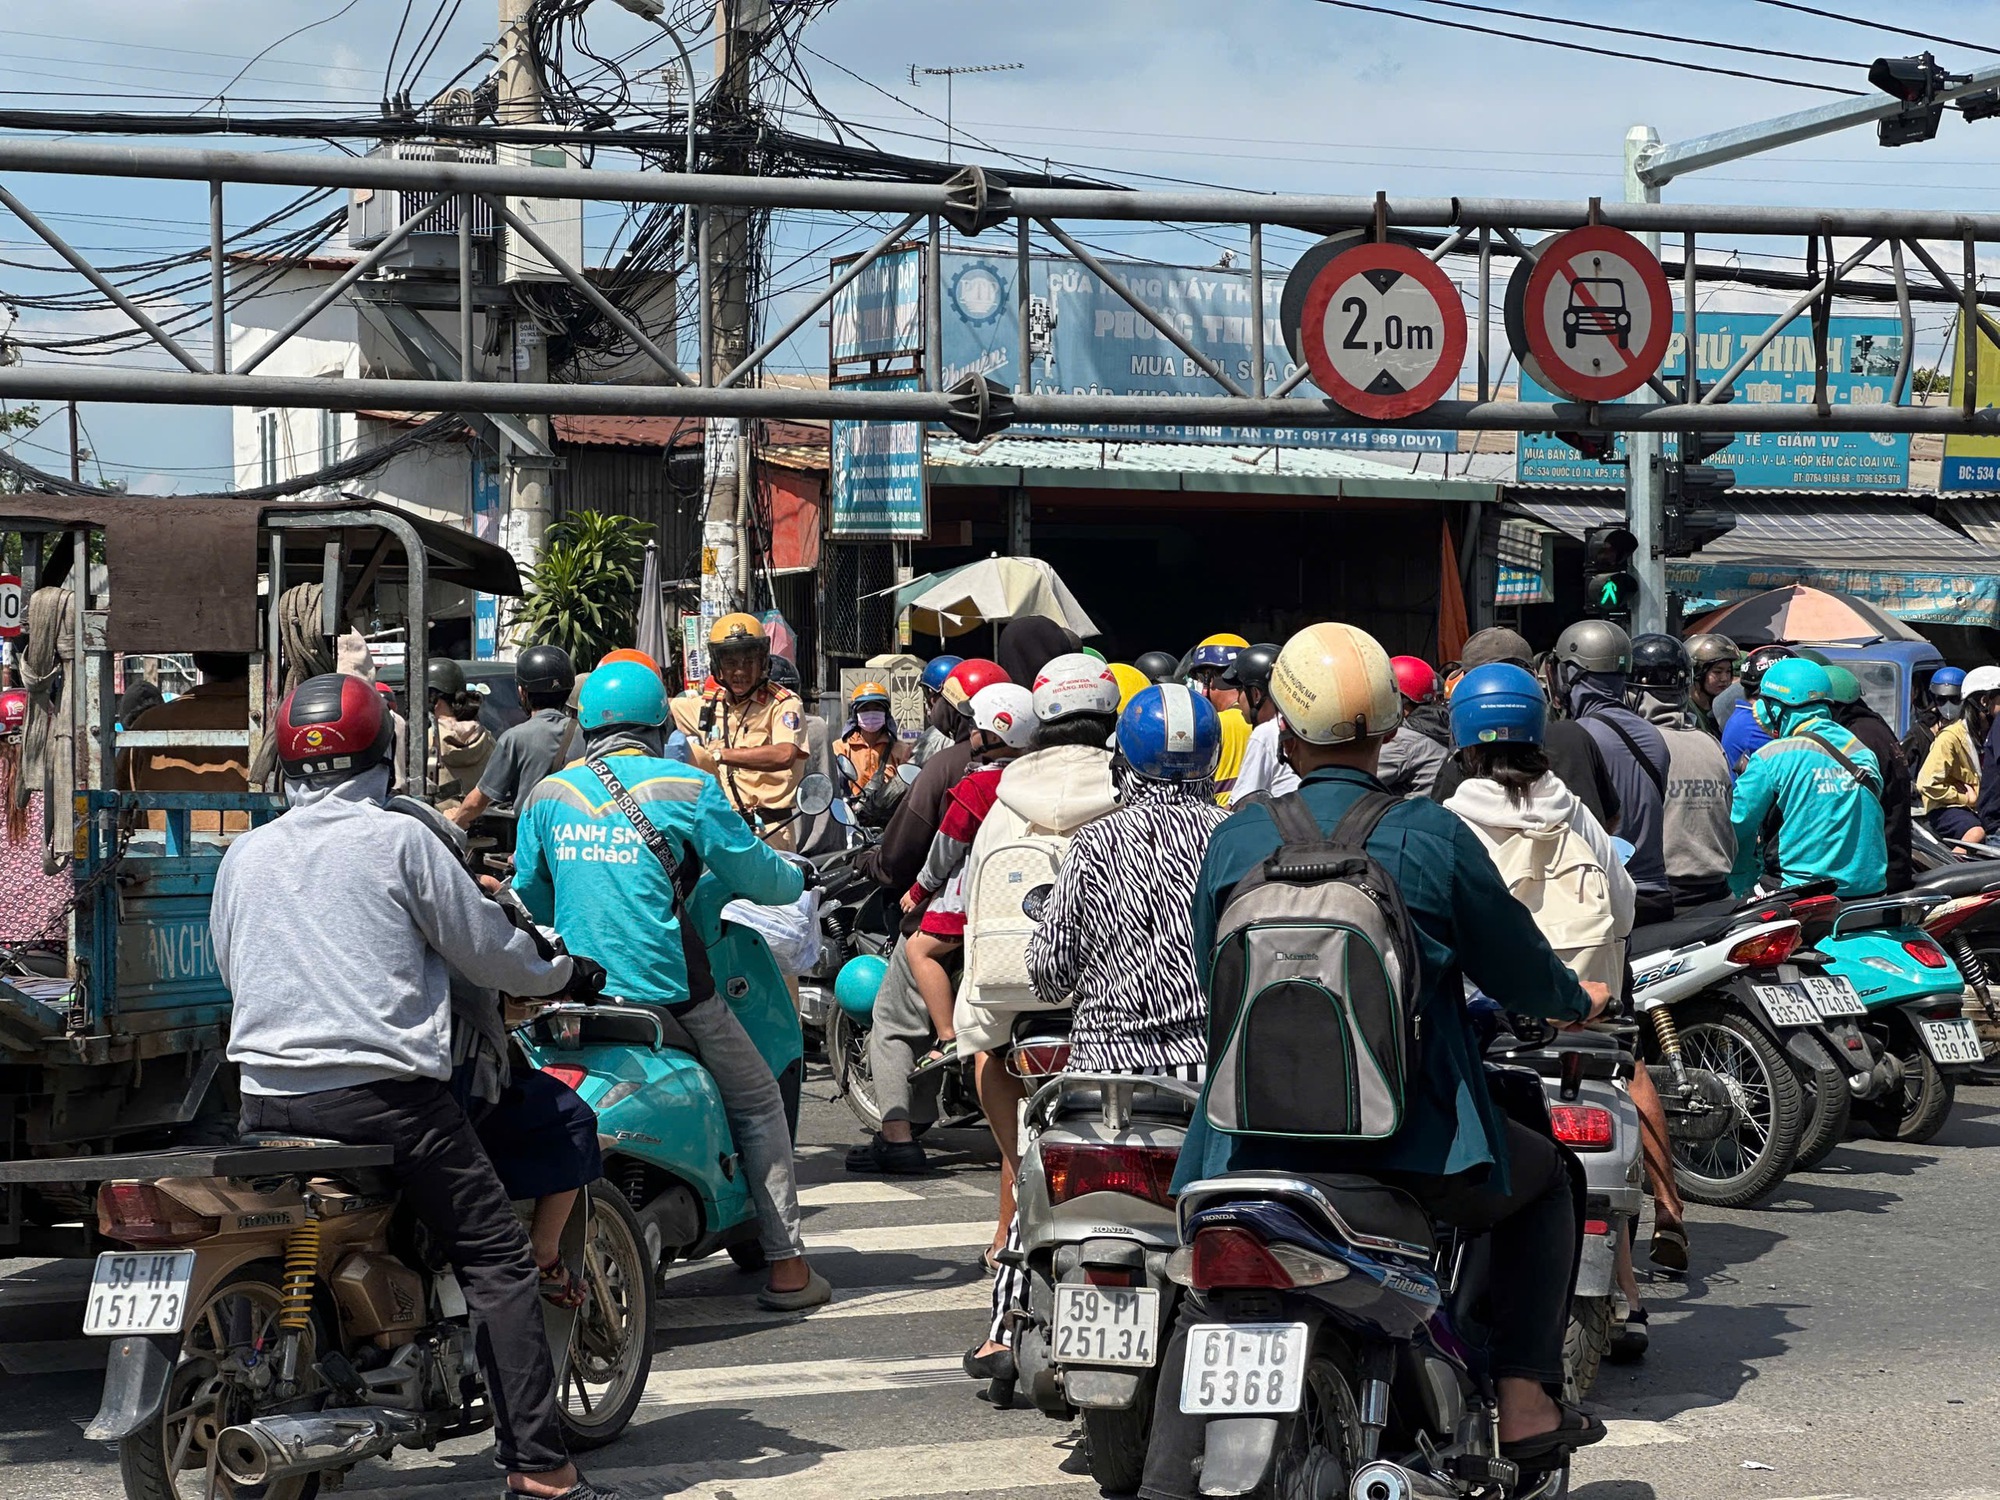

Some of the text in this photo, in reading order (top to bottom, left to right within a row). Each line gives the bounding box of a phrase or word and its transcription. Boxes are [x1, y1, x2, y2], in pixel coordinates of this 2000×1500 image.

[1049, 268, 1093, 293] CỬA
[1169, 277, 1217, 300] MÁY
[1222, 281, 1284, 304] THẾT
[1342, 296, 1433, 356] 2,0m
[1131, 355, 1176, 377] MUA
[1746, 381, 1884, 406] TIỆN PHY BÀO
[1274, 429, 1298, 440] ĐT:
[1302, 430, 1337, 442] 0917
[1341, 431, 1367, 443] 415
[1371, 432, 1398, 444] 969
[1401, 434, 1442, 448] (DUY)
[1821, 436, 1840, 448] VV
[1524, 448, 1545, 460] MUA
[1837, 453, 1857, 467] CÁC
[1859, 456, 1880, 471] LOẠI
[1959, 465, 1994, 481] ĐC: 534
[1291, 690, 1311, 711] Bank
[611, 828, 644, 845] SM
[581, 843, 640, 865] chào!
[1762, 986, 1803, 1004] 67-B2
[1817, 995, 1863, 1014] 740.64
[1771, 1005, 1819, 1024] 335.24
[1930, 1023, 1971, 1041] 59-TA
[1935, 1041, 1979, 1060] 139.18
[237, 1212, 295, 1229] HONDA
[1202, 1214, 1237, 1222] HONDA
[1091, 1226, 1134, 1235] HONDA
[108, 1256, 177, 1290] 59-H1
[94, 1293, 180, 1329] 151.73
[1070, 1291, 1140, 1326] 59-P1
[1058, 1325, 1150, 1361] 251.34
[1203, 1331, 1290, 1367] 61-T6
[1198, 1369, 1285, 1406] 5368
